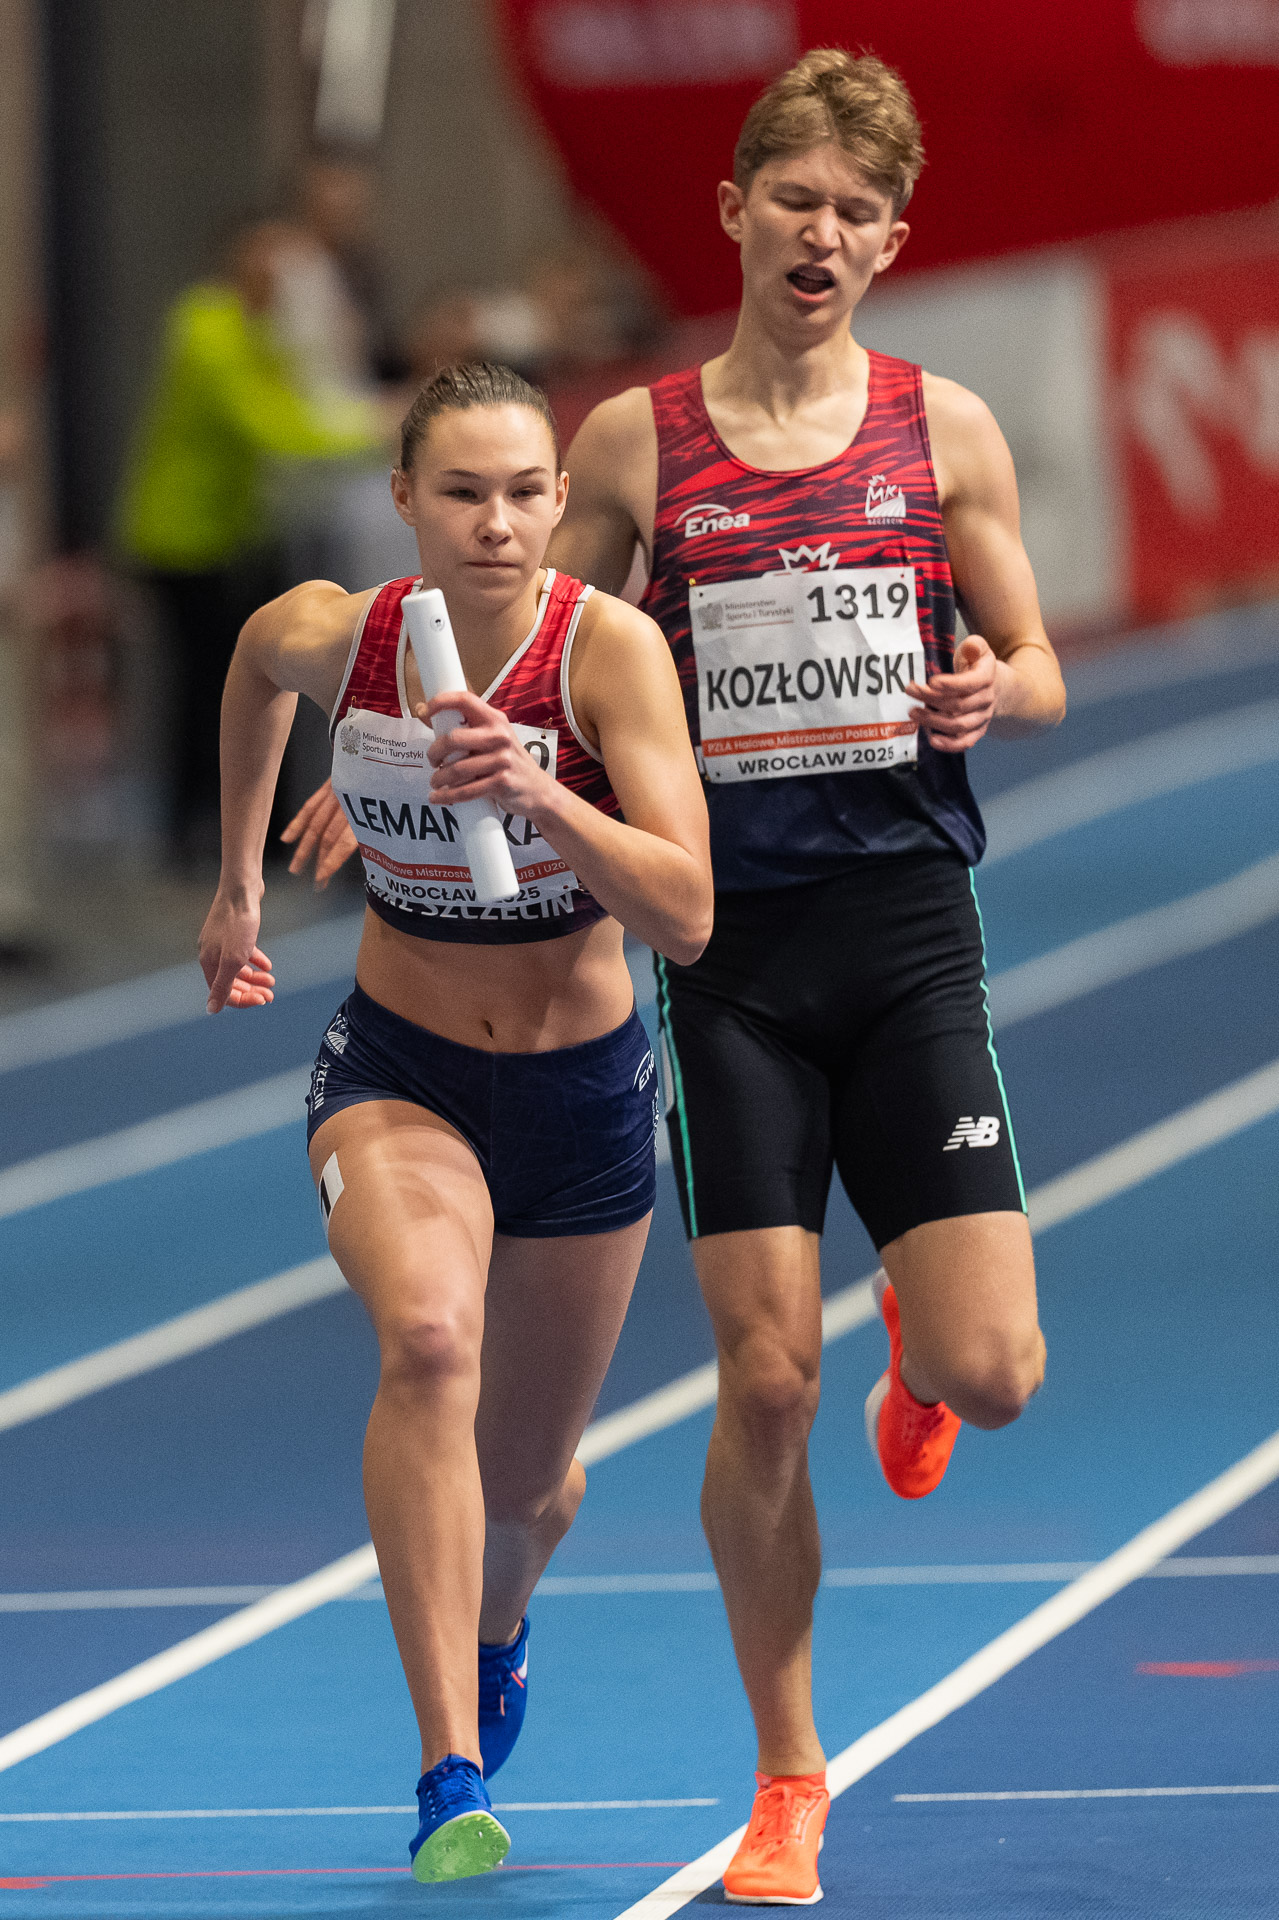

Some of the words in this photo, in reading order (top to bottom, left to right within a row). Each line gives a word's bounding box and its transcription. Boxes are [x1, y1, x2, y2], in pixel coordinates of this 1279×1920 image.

[684, 511, 750, 538] Enea
[807, 582, 909, 623] 1319
[706, 653, 915, 711] KOZŁOWSKI
[362, 732, 407, 748] Ministerstwo
[777, 731, 843, 746] Mistrzostwa
[845, 727, 878, 739] Polski
[362, 743, 384, 755] Sportu
[389, 749, 424, 759] Turystyki
[738, 751, 846, 775] WROCŁAW
[852, 746, 894, 764] 2025
[364, 847, 382, 862] PZLA
[382, 858, 413, 876] Halowe
[543, 861, 566, 873] U20
